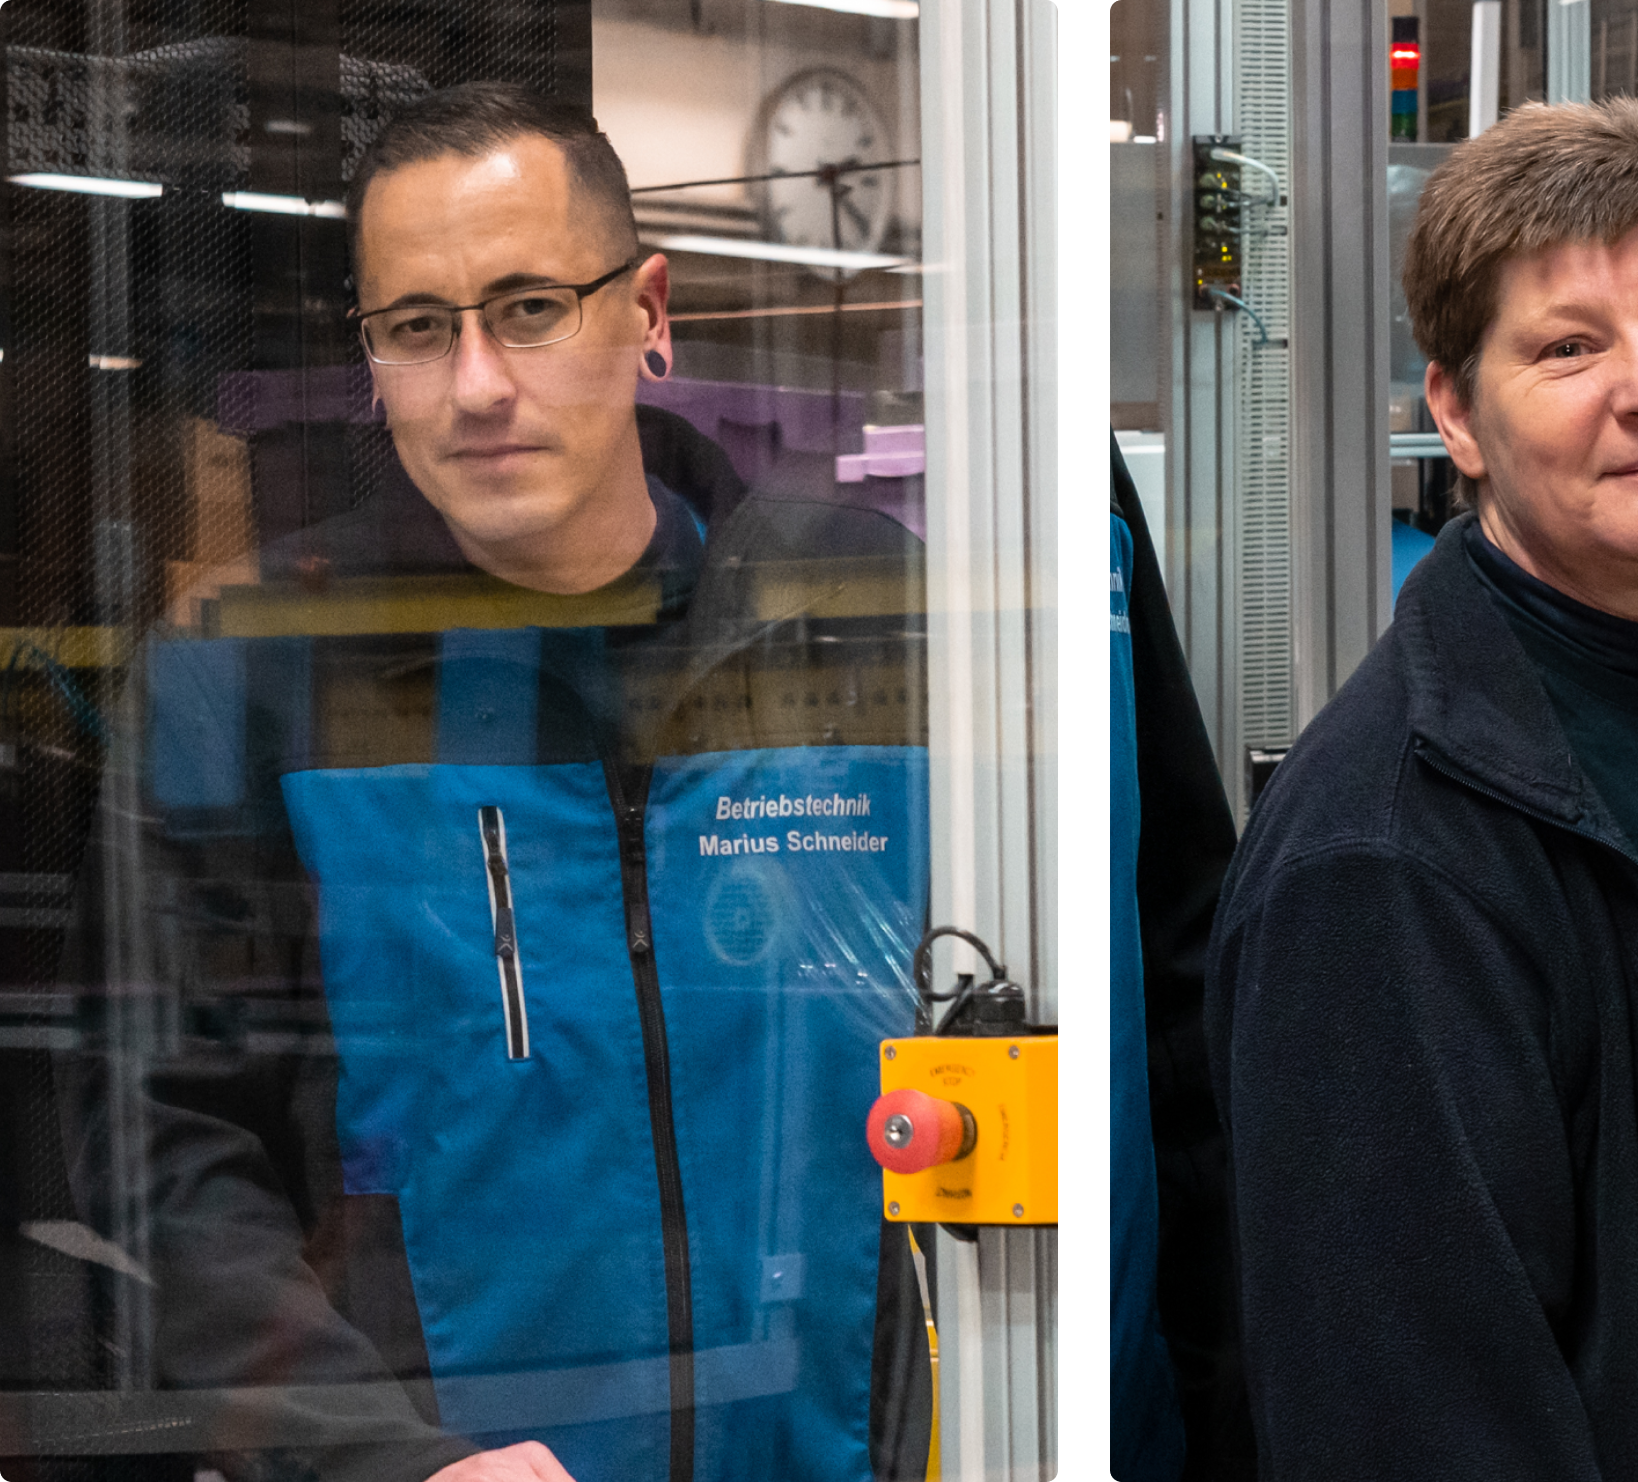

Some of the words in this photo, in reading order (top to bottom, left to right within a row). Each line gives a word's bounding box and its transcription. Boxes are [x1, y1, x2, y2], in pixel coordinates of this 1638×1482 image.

[715, 793, 871, 820] Betriebstechnik
[699, 833, 780, 856] Marius
[787, 830, 888, 852] Schneider
